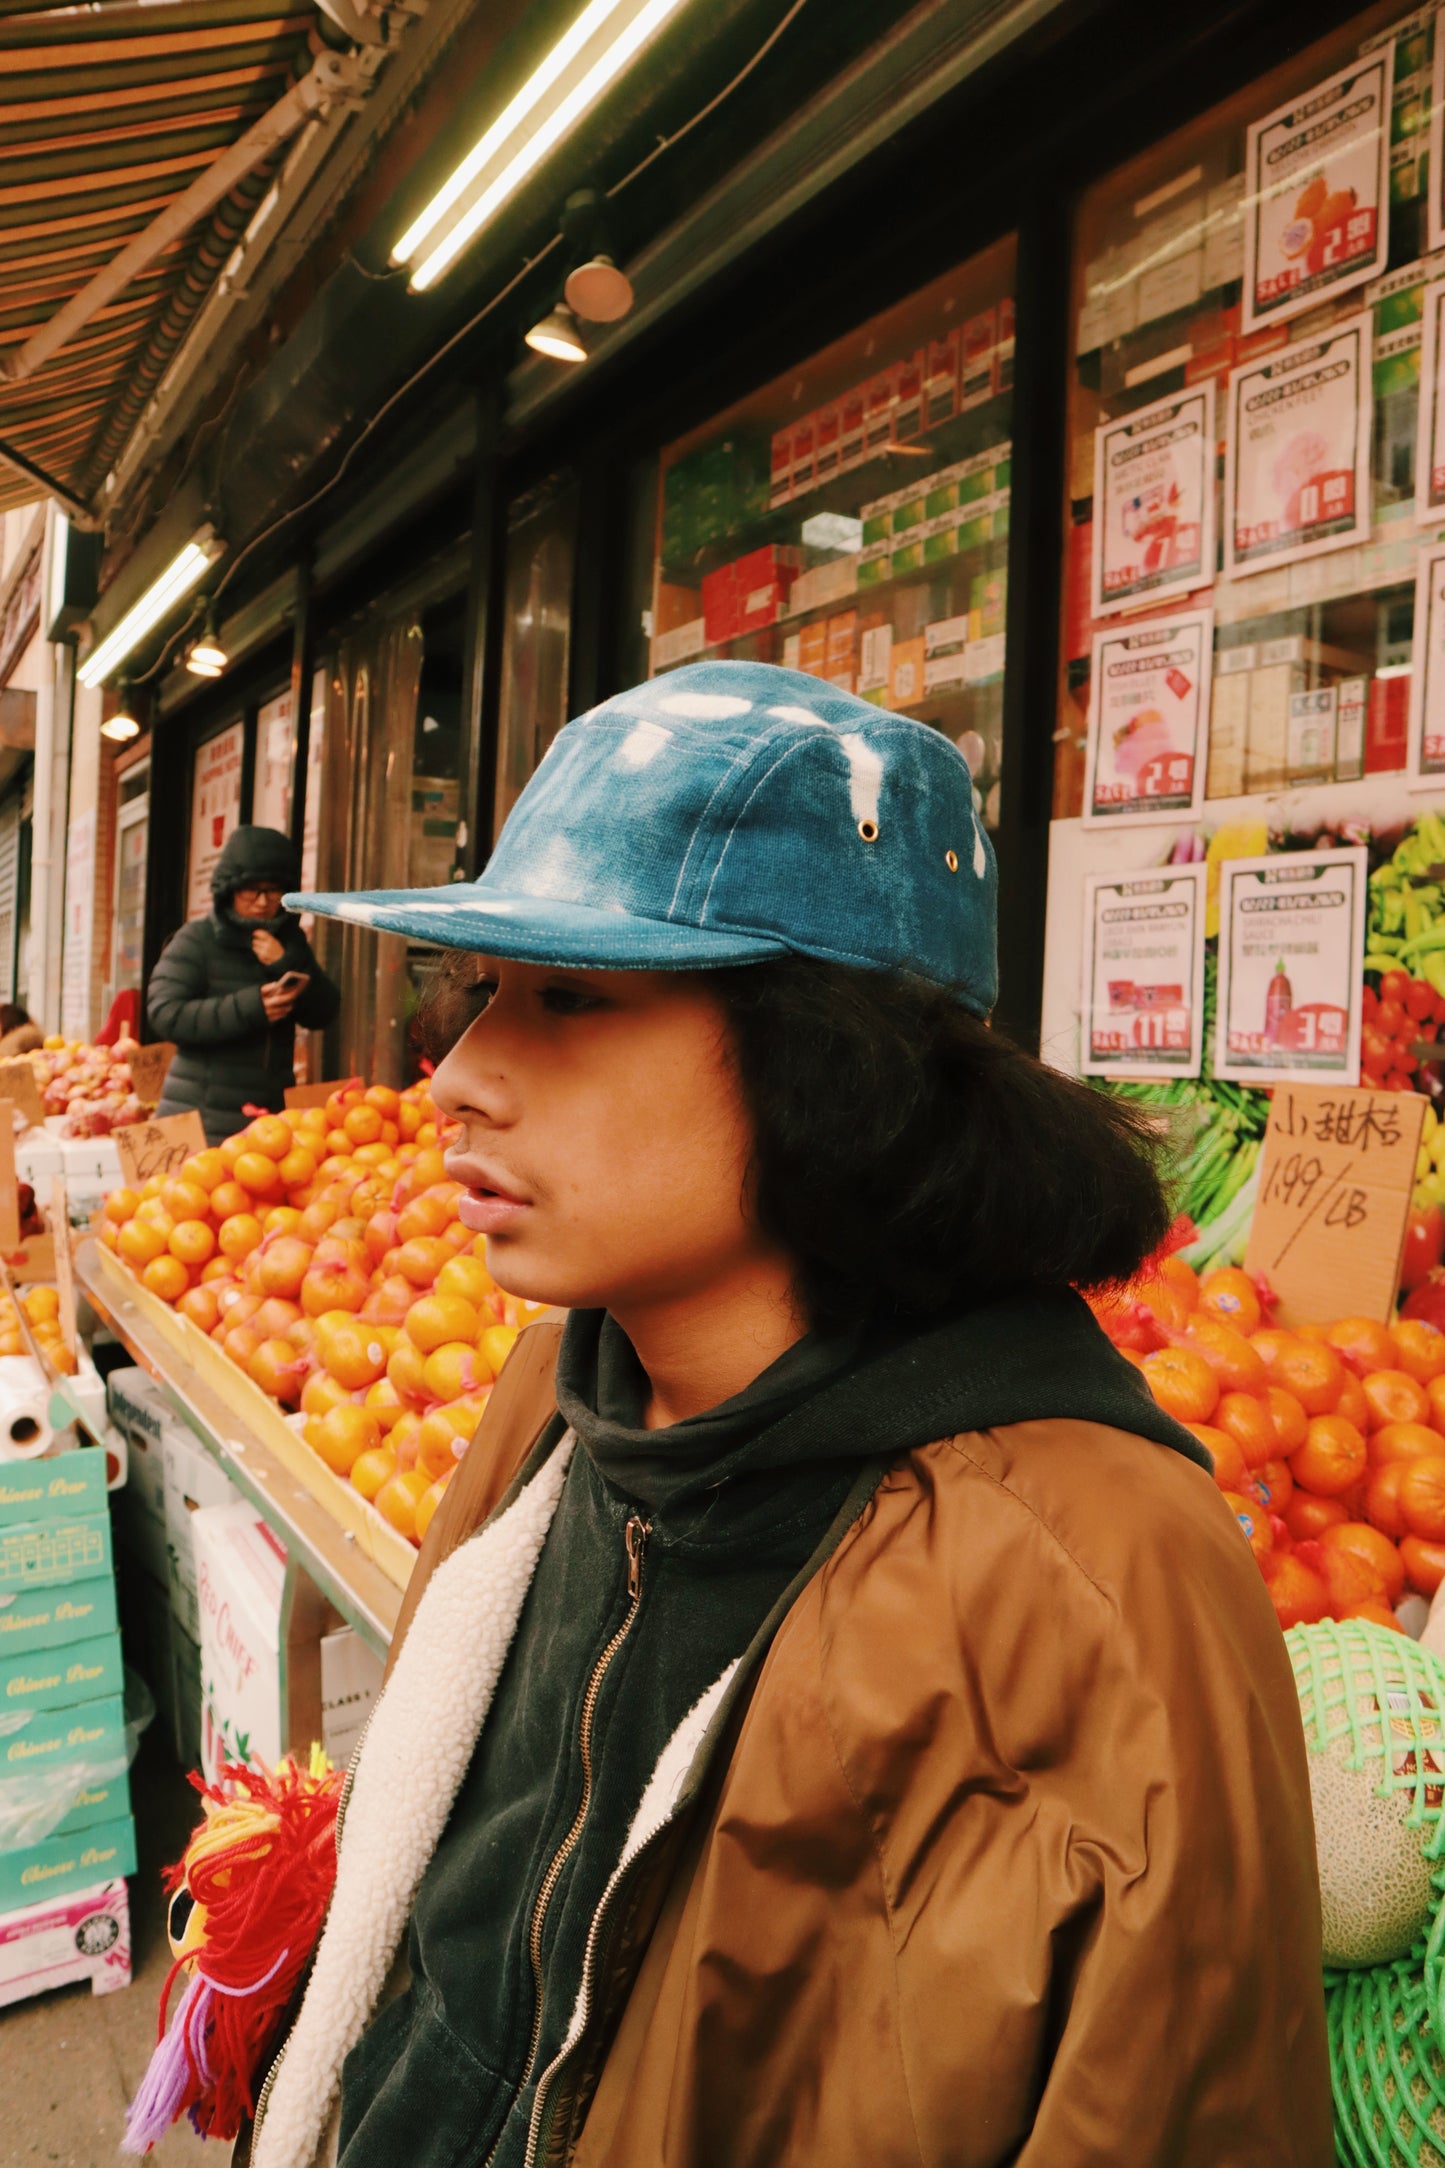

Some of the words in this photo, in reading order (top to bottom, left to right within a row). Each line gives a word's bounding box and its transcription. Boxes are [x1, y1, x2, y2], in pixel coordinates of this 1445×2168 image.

[6, 1675, 61, 1697] Chinese
[65, 1663, 104, 1684] Pear
[7, 1739, 62, 1761] Chinese
[67, 1727, 104, 1746] Pear
[21, 1860, 75, 1886] Chinese
[80, 1847, 117, 1868] Pear
